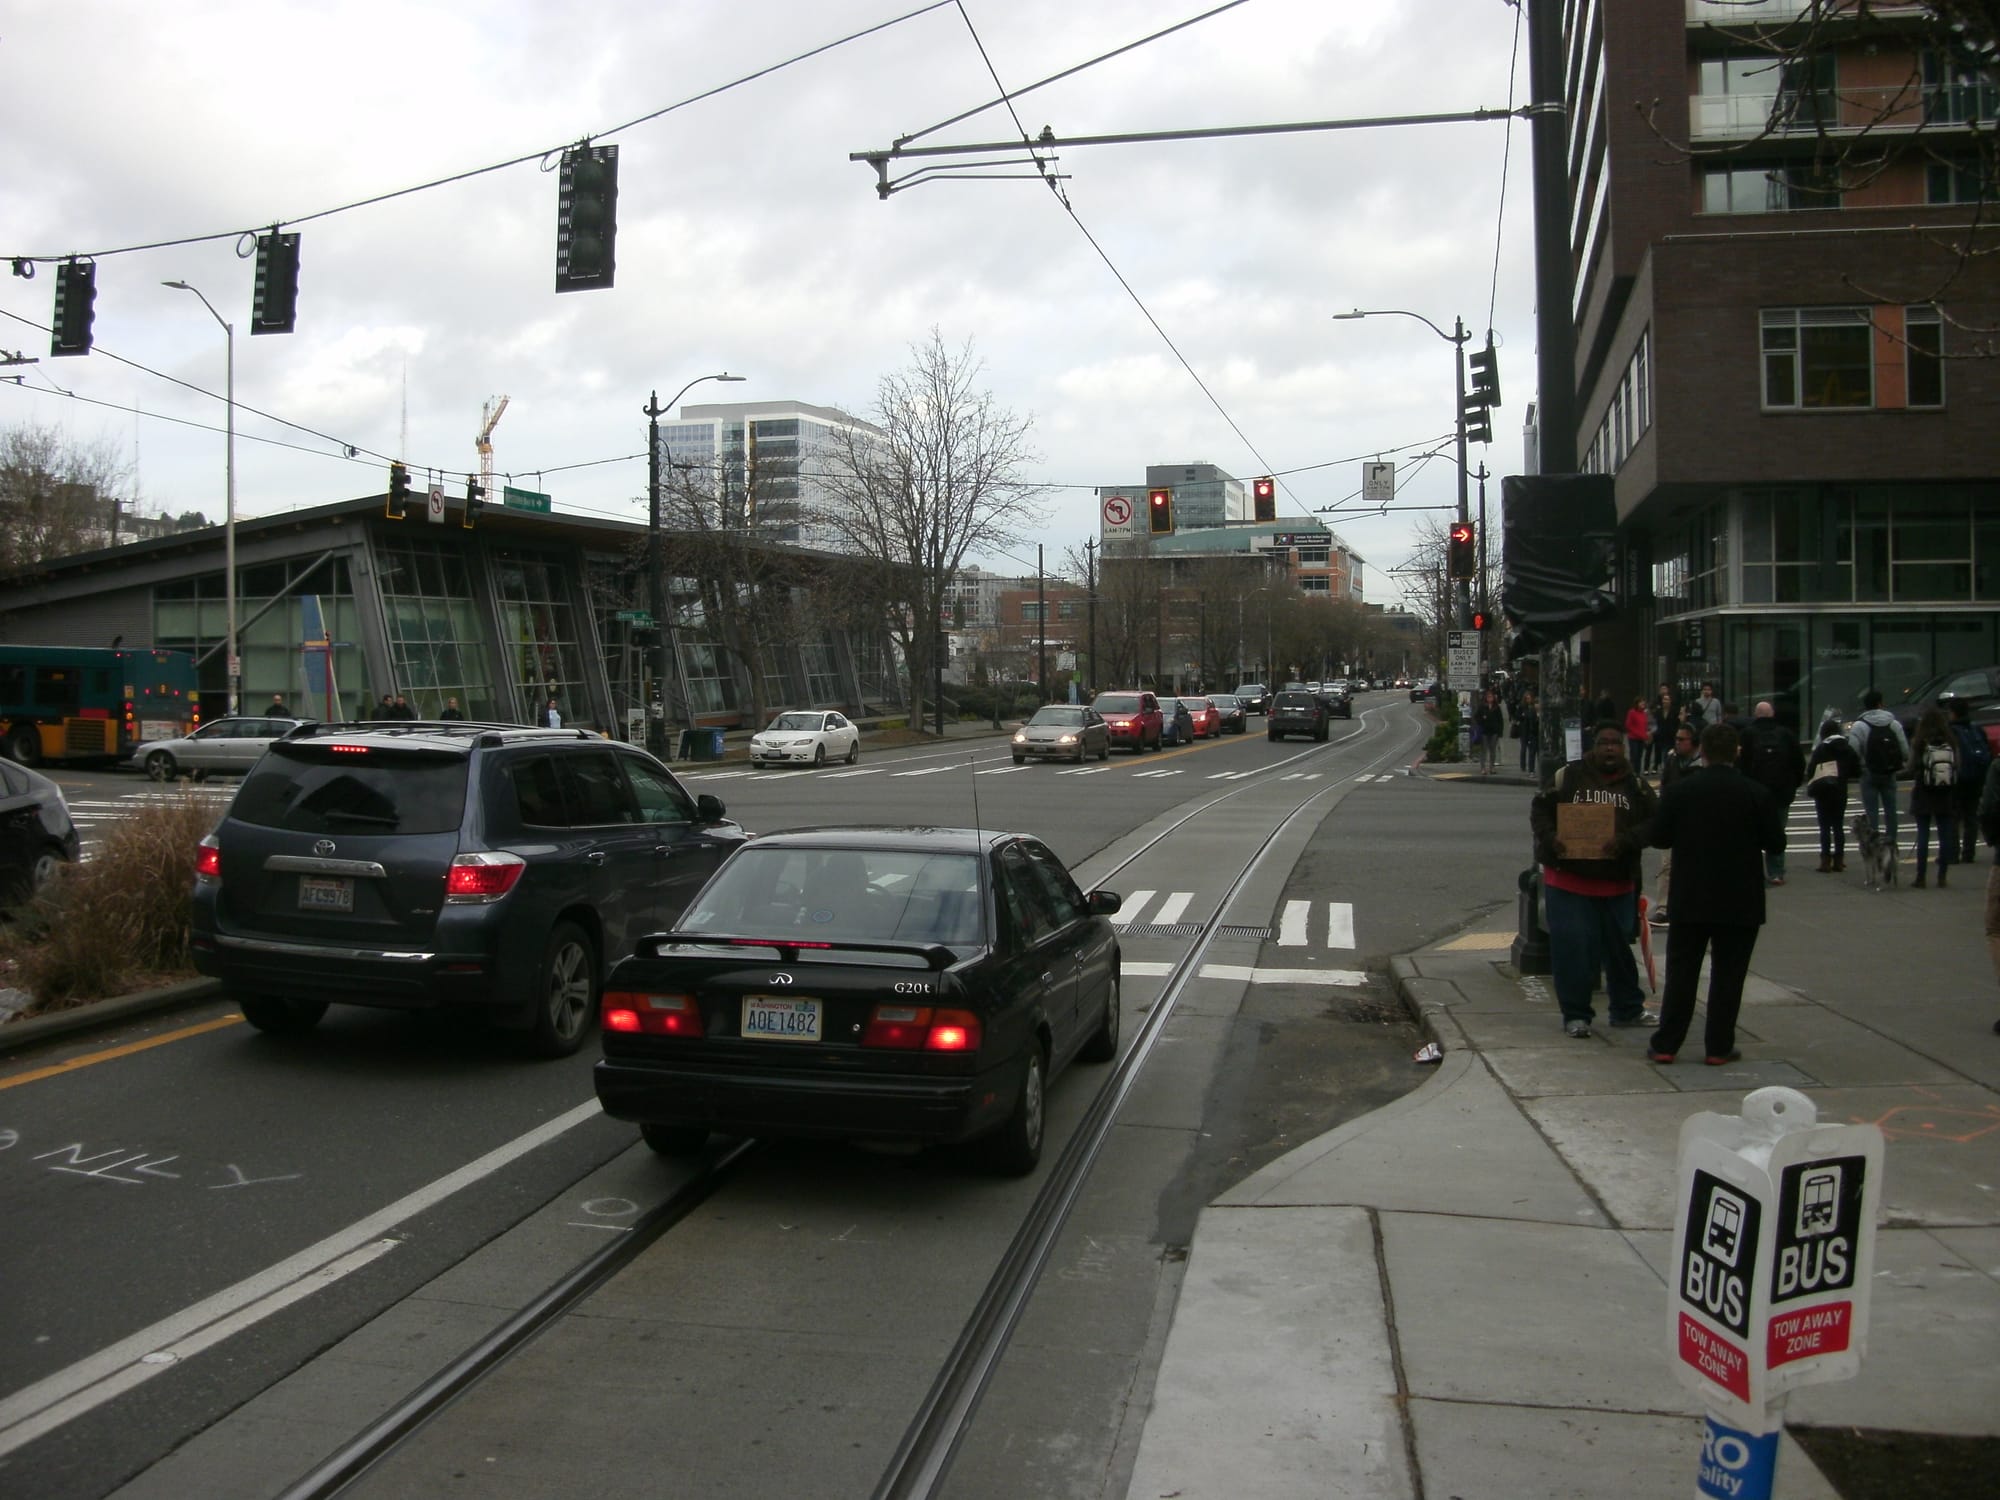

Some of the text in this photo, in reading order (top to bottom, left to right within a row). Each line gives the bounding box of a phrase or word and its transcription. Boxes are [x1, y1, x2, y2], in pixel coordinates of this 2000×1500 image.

[1586, 789, 1630, 810] LOOMIS
[894, 982, 931, 994] G20t
[751, 1002, 792, 1010] WASHINGTON
[1778, 1237, 1848, 1296] BUS
[1686, 1250, 1743, 1326] BUS
[1774, 1310, 1843, 1338] TOW AWAY
[1685, 1322, 1742, 1372] TOW AWAY
[1786, 1332, 1822, 1354] ZONE
[1698, 1350, 1728, 1382] ZONE
